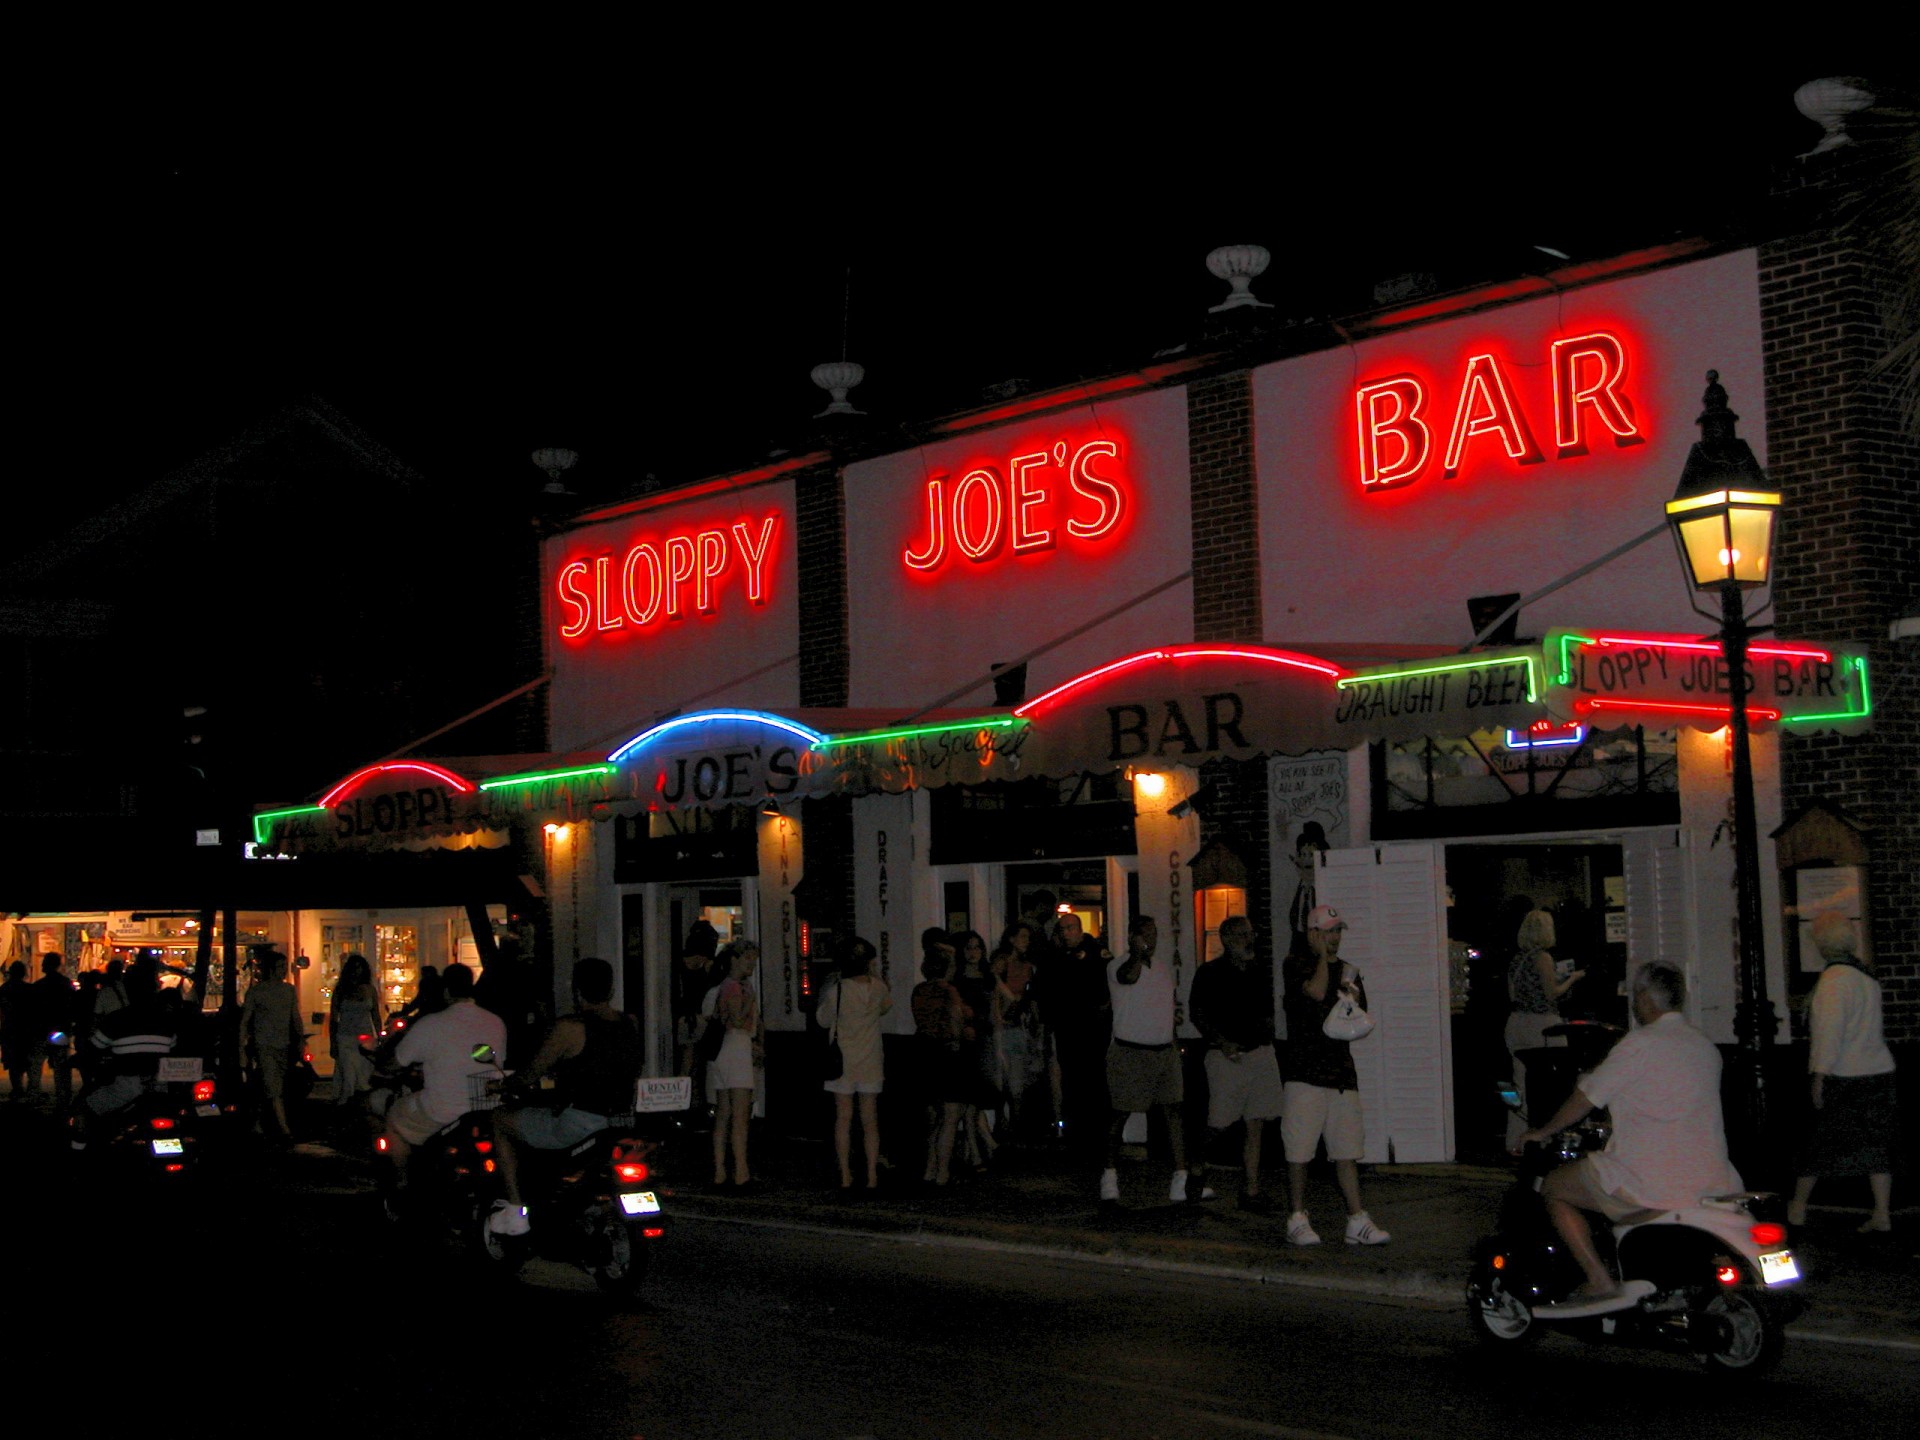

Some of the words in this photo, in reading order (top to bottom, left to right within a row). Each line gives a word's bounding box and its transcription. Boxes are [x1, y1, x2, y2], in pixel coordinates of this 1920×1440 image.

[1356, 332, 1643, 491] BAR
[904, 440, 1128, 568] JOE'S
[557, 516, 776, 639] SLOPPY
[1335, 673, 1451, 724] DRAUGHT
[1774, 661, 1836, 697] BAR
[1106, 692, 1251, 761] BAR
[662, 746, 798, 803] JOE'S
[335, 786, 453, 838] SLOPPY
[778, 816, 790, 887] PINA
[877, 830, 888, 917] DRAFT
[1169, 850, 1185, 1027] COCKTAILS
[647, 1081, 681, 1093] RENTAL
